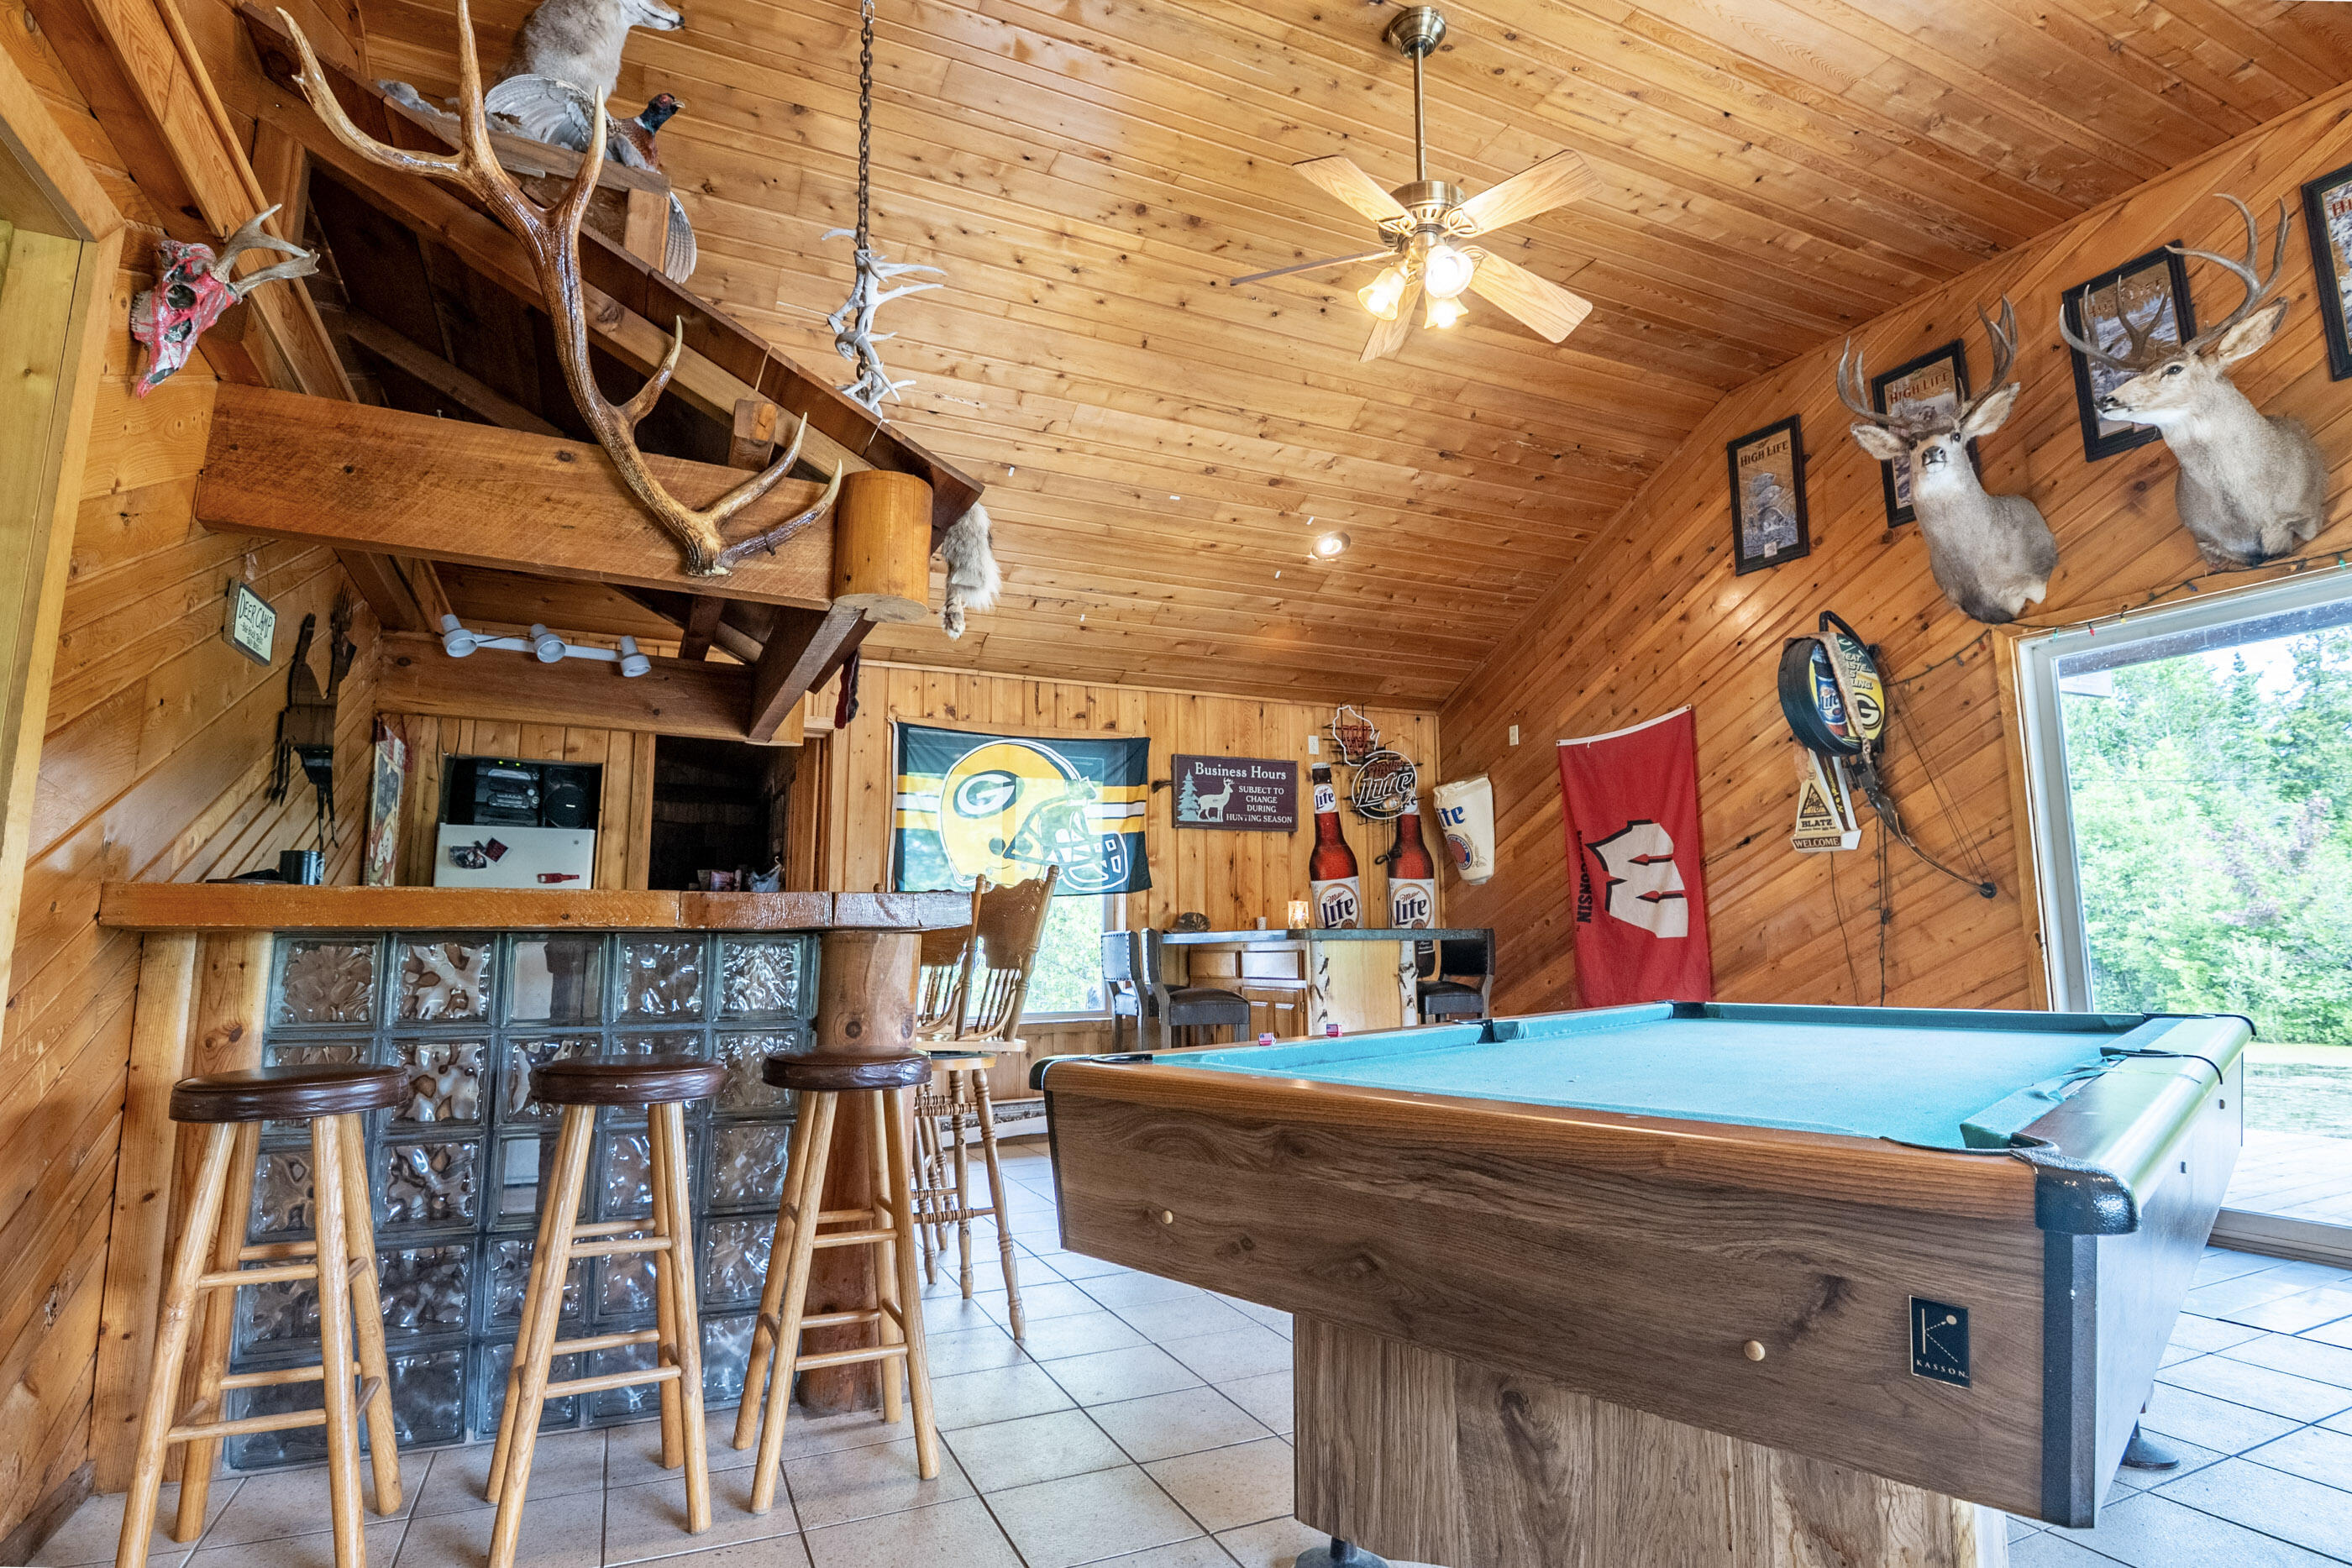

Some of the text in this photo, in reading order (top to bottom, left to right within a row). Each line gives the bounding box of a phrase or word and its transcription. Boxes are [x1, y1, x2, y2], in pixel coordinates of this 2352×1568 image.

[1890, 371, 1950, 404] HIGH LIFE
[1740, 440, 1789, 467] HIGH LIFE
[239, 592, 256, 628] DEER
[255, 607, 273, 638] CAMP
[1194, 762, 1287, 780] Business Hours
[1238, 785, 1284, 795] SUBJECT TO
[1356, 772, 1414, 808] Lite
[1246, 795, 1278, 804] CHANGE
[1315, 792, 1334, 810] Lite
[1247, 805, 1277, 813] DURING
[1436, 805, 1466, 831] ite
[1226, 813, 1293, 824] HUNTING SEASON
[1801, 819, 1833, 828] BLATZ
[1794, 837, 1840, 847] WELCOME
[1326, 890, 1346, 905] Miller
[1399, 890, 1420, 903] Miller
[1321, 898, 1355, 929] Lite
[1394, 899, 1427, 926] Lite
[1916, 1359, 1966, 1377] KASSON
